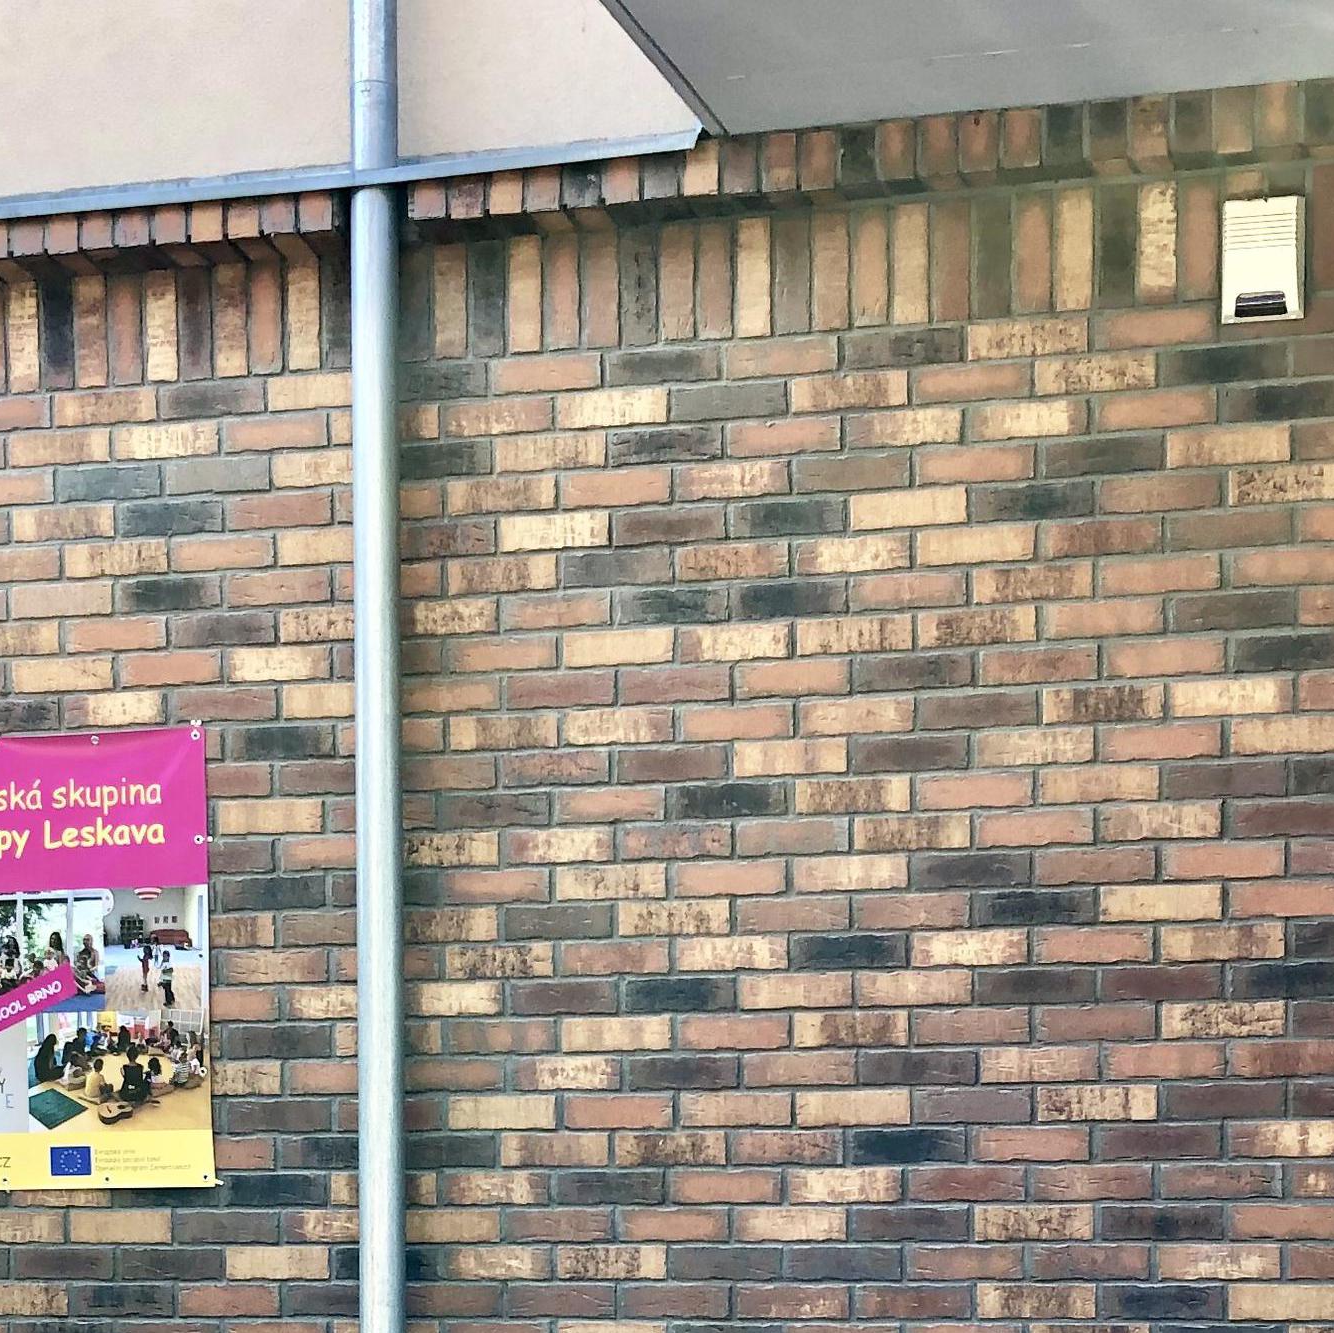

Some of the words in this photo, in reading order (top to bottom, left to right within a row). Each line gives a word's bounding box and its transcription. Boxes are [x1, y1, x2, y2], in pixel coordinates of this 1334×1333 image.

[51, 777, 162, 816] skupina
[43, 817, 166, 849] Leskava
[27, 980, 63, 1006] BRNO
